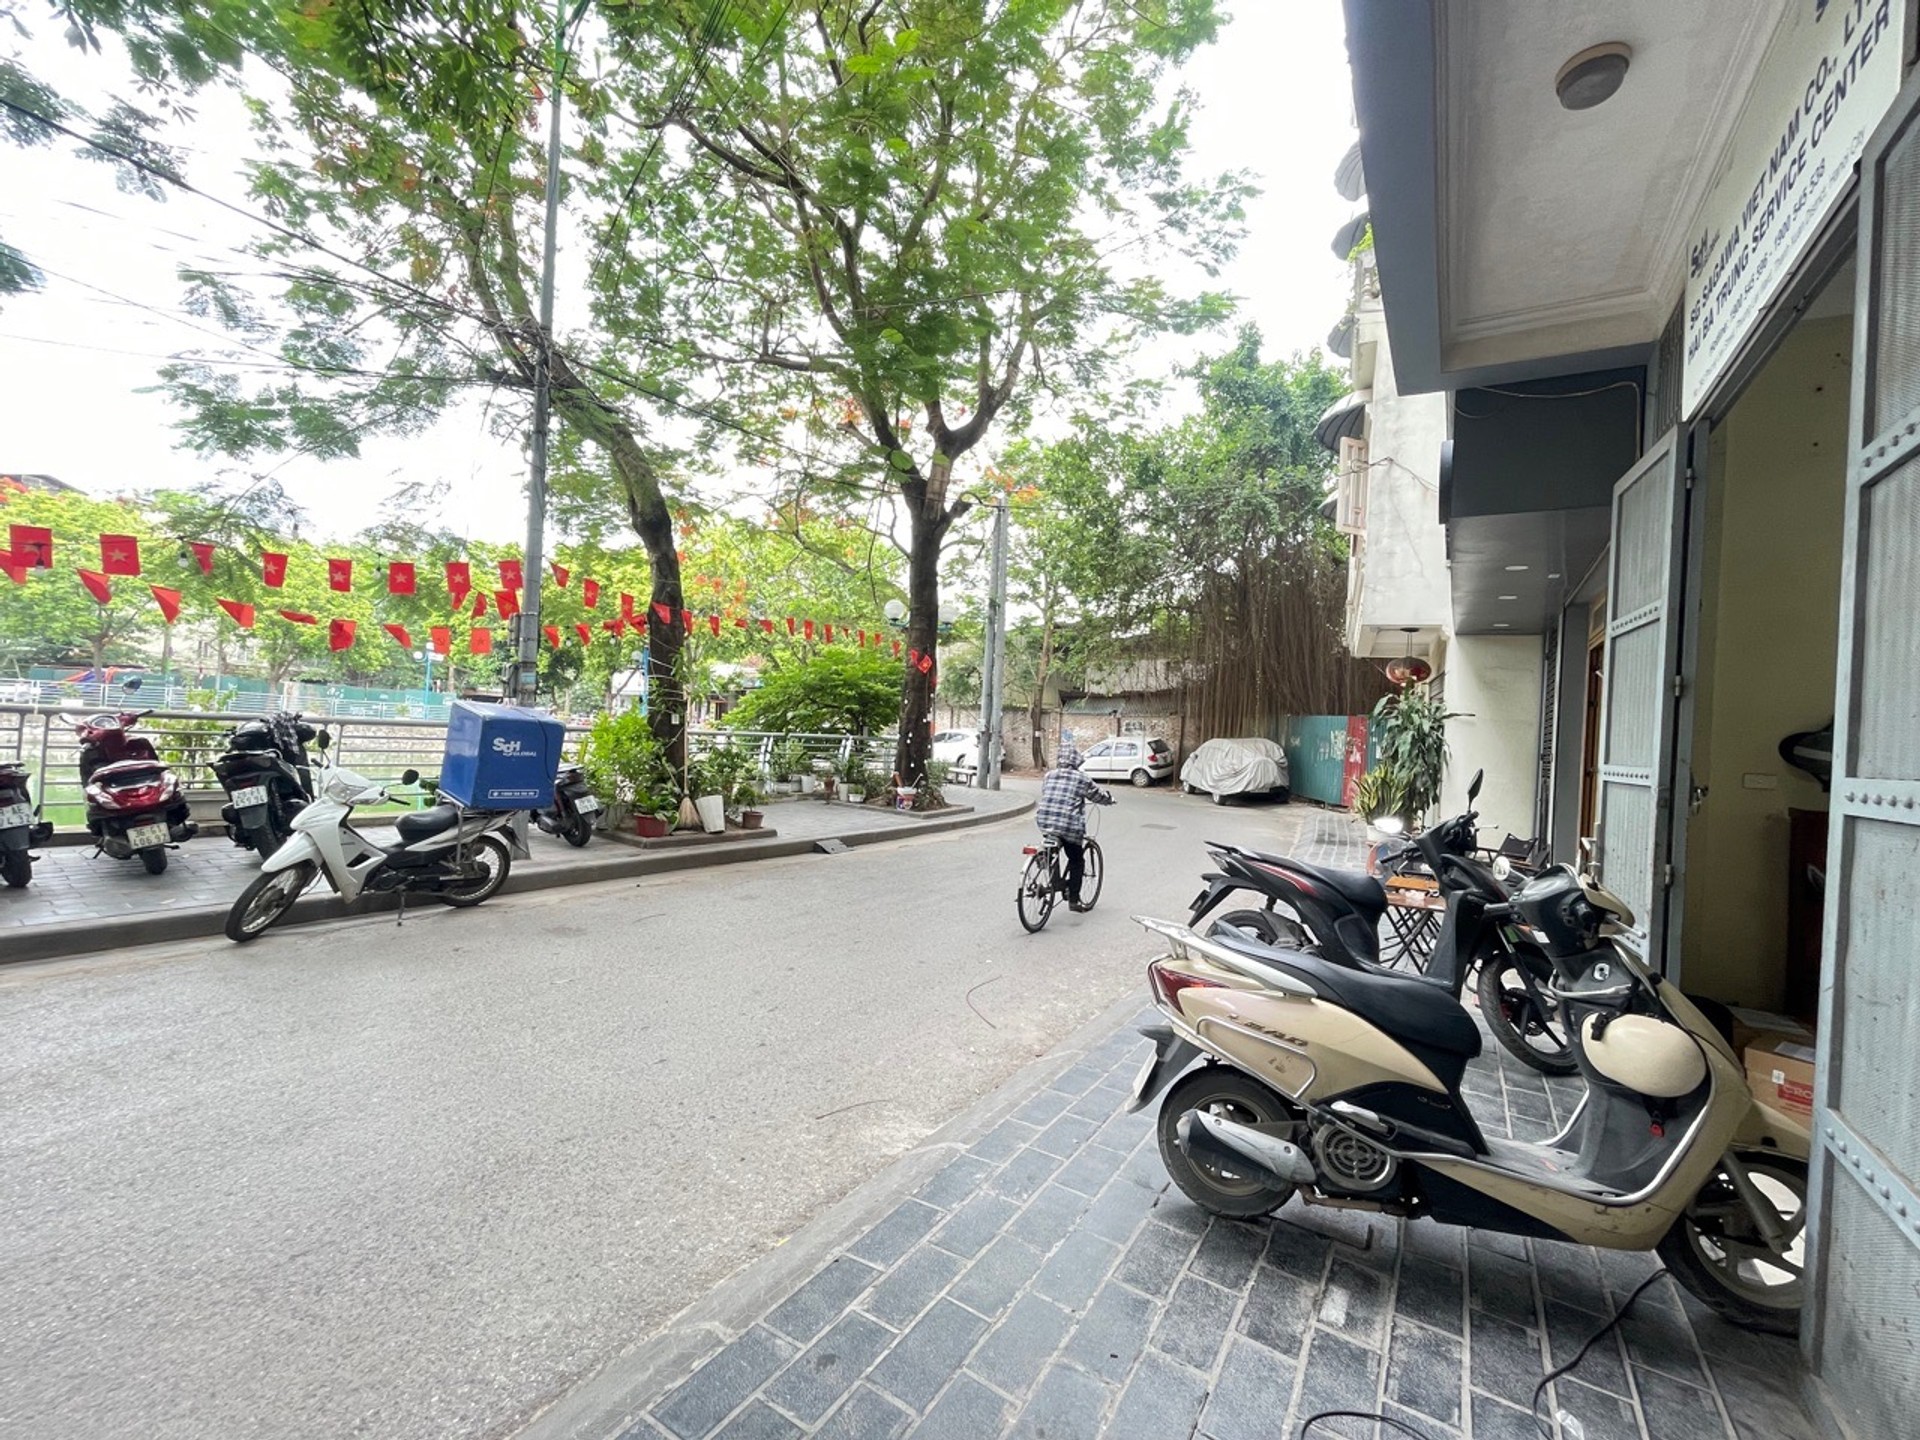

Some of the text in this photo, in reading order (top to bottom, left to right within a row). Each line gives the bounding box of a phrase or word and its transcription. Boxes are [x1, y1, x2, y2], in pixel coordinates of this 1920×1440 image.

[1702, 225, 1739, 308] SAGAWA
[1742, 170, 1766, 232] VIET
[1769, 106, 1799, 184] NAM
[1844, 0, 1872, 47] LT
[1702, 307, 1714, 340] BA
[1716, 244, 1748, 315] TRUNG
[1752, 137, 1807, 254] SERVICE
[1811, 0, 1889, 149] CENTER
